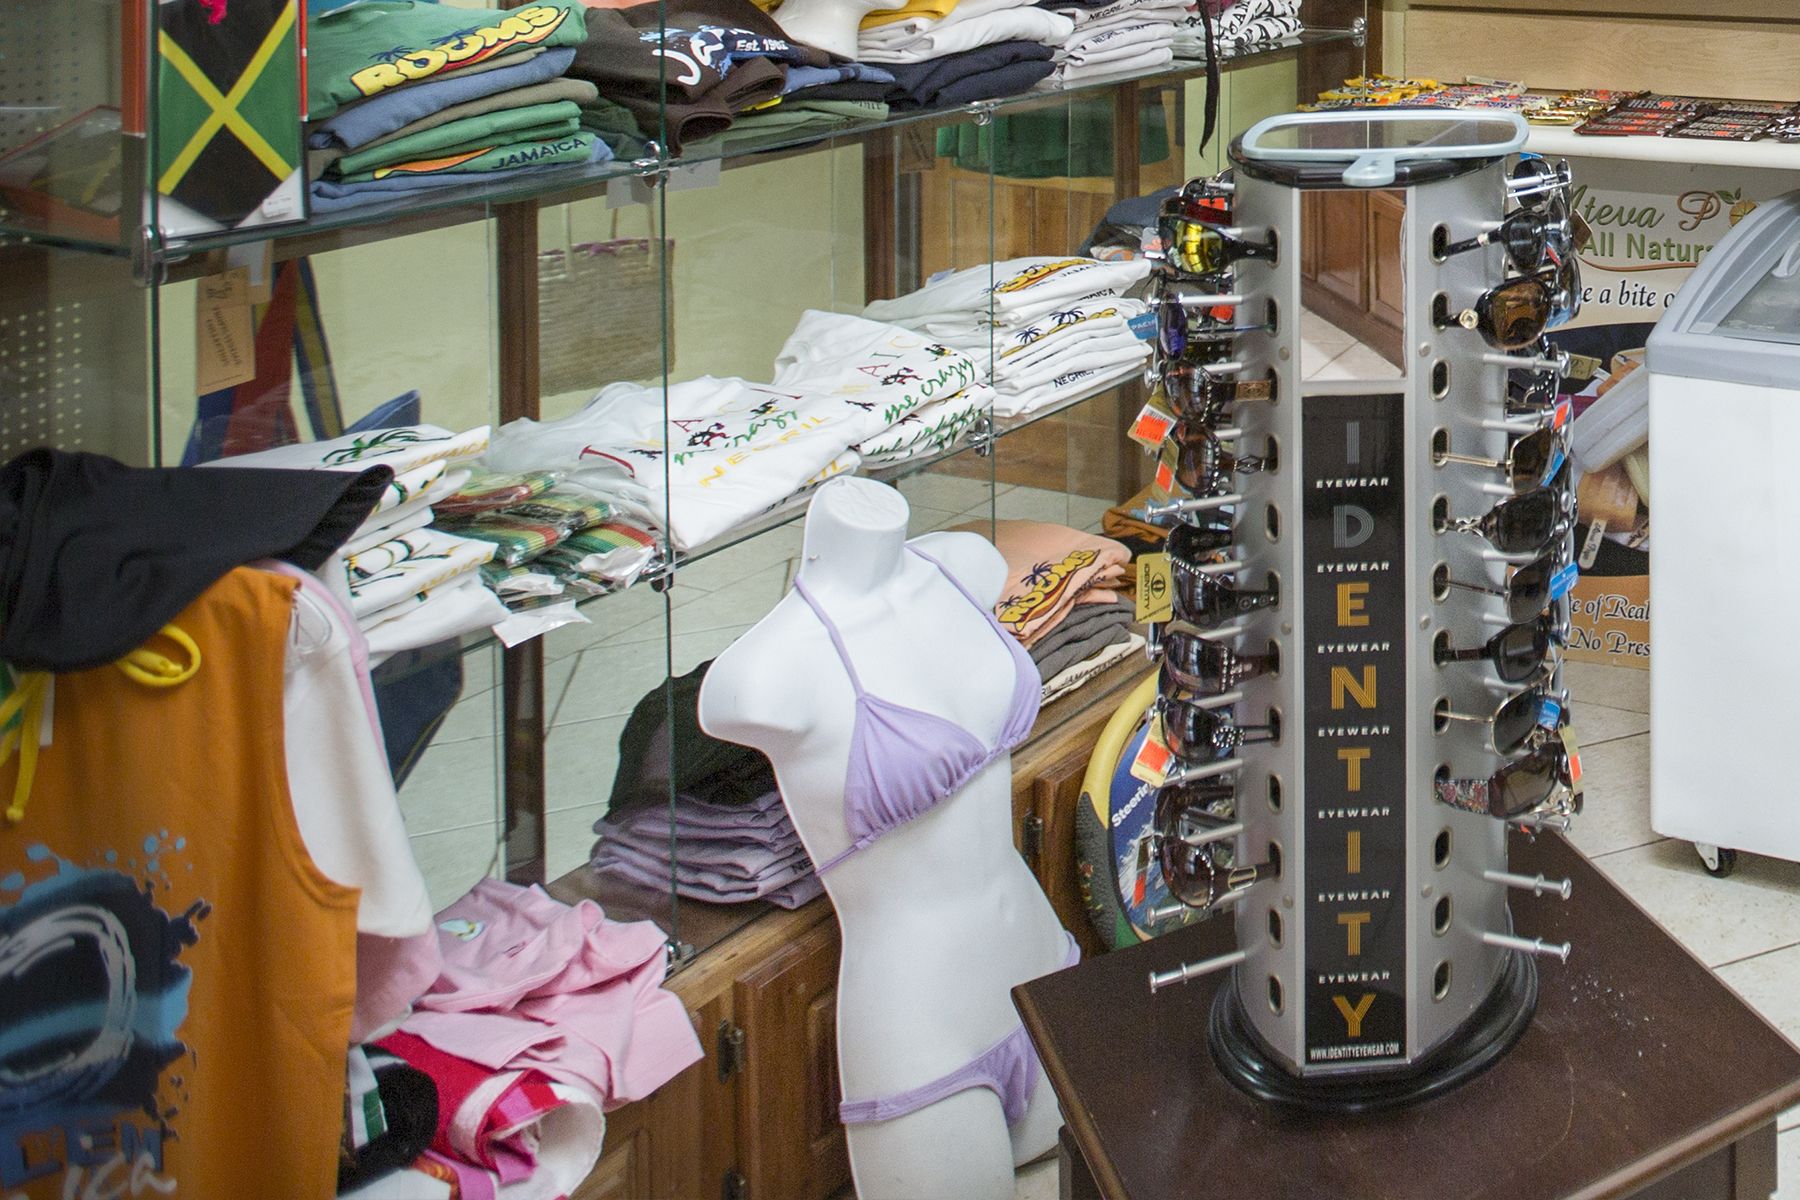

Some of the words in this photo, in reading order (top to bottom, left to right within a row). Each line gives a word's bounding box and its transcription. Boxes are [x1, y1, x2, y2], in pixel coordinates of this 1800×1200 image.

[351, 5, 563, 96] ROOMS
[735, 38, 760, 53] Est.
[492, 137, 587, 171] JAMAICA
[1578, 231, 1615, 258] All
[1599, 288, 1611, 304] a
[1619, 280, 1657, 308] bite
[922, 357, 977, 404] crazy
[1315, 477, 1390, 489] EYEWEAR
[1316, 561, 1390, 573] EYEWEAR
[997, 547, 1099, 624] ROOMS
[1584, 595, 1603, 623] of
[1569, 627, 1602, 650] No
[1316, 642, 1391, 654] EYEWEAR
[1317, 725, 1391, 737] EYEWEAR
[1317, 807, 1391, 818] EYEWEAR
[1317, 889, 1391, 901] EYEWEAR
[1317, 971, 1391, 983] EYEWEAR
[1309, 1042, 1400, 1060] WWW.IDENTITYEYEWEAR.COM
